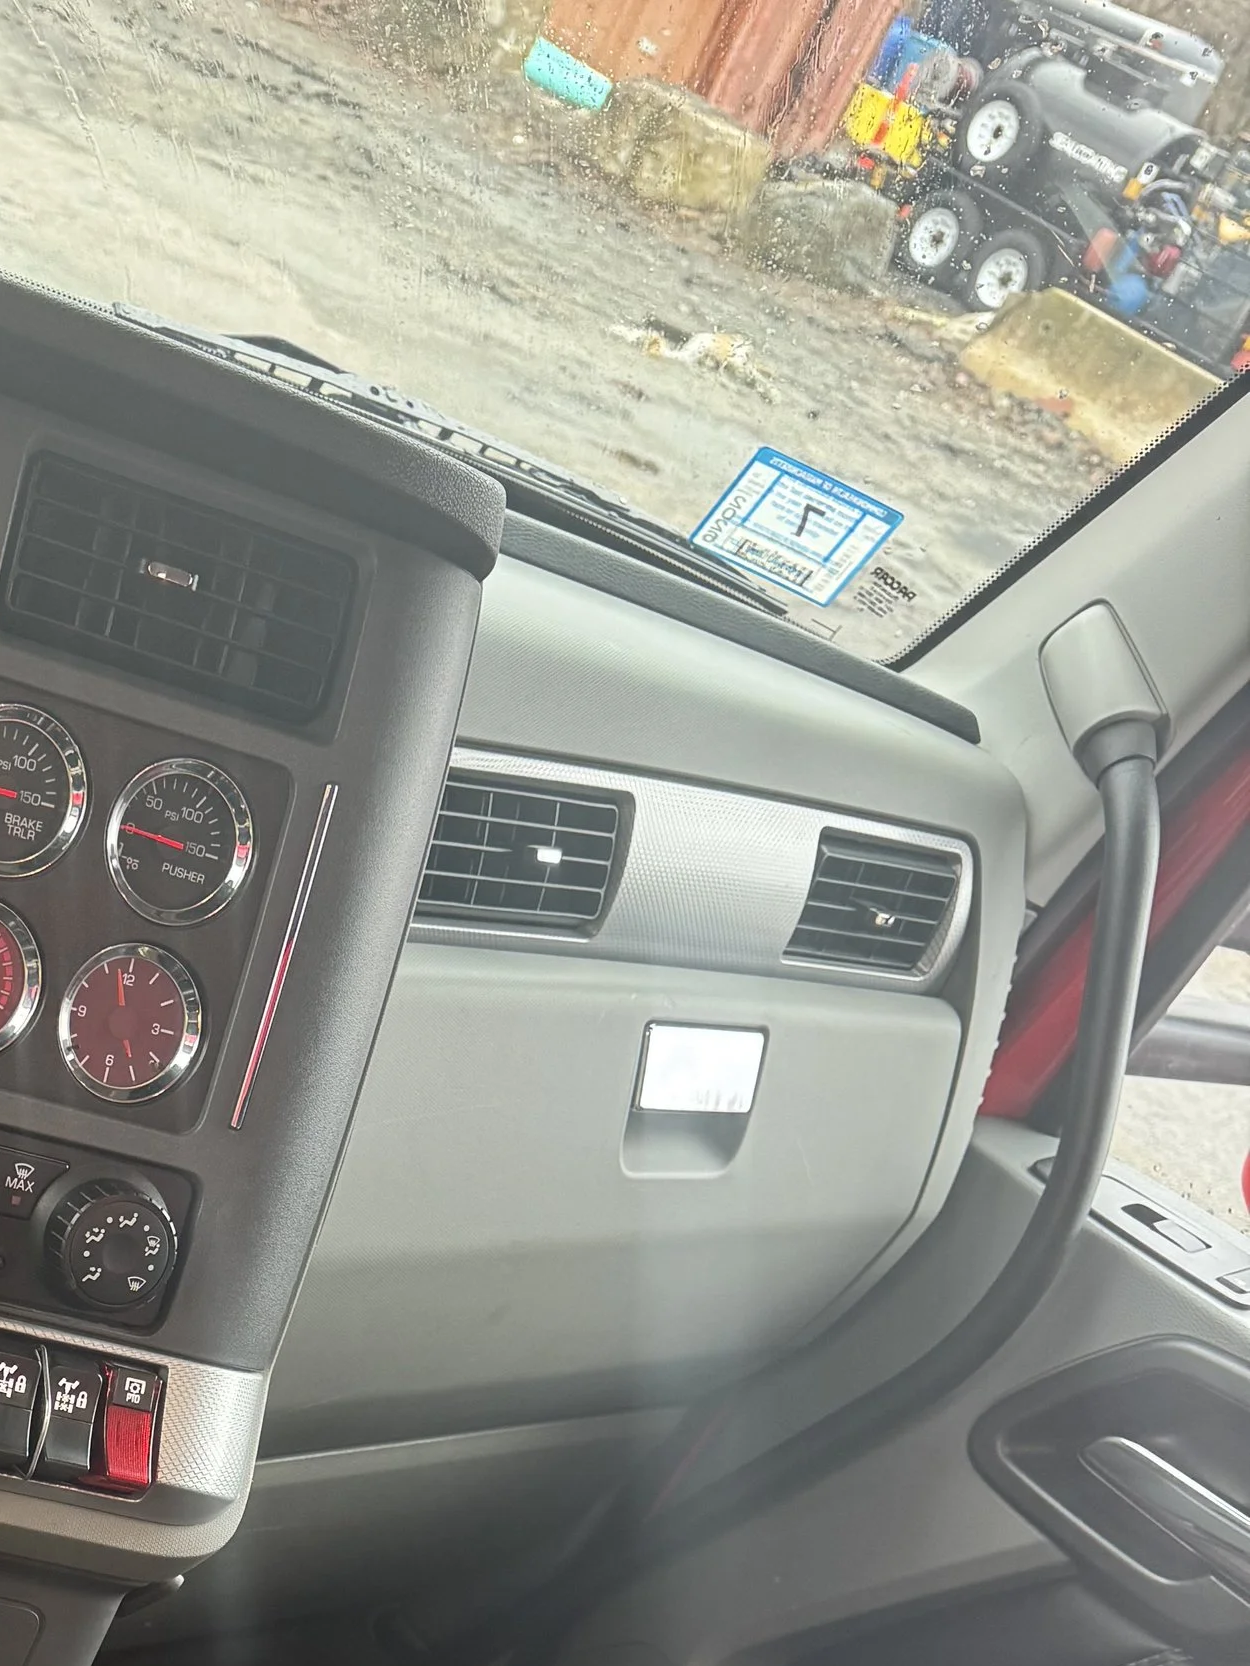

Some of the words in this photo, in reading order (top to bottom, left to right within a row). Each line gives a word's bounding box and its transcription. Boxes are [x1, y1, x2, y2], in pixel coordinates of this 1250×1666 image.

[13, 755, 37, 772] 100
[19, 790, 41, 806] 150
[145, 796, 163, 811] 50
[4, 812, 43, 832] BRAKE
[164, 810, 179, 822] PSI
[181, 806, 204, 824] 100
[7, 824, 36, 841] TRLR
[185, 841, 206, 857] 150
[161, 862, 205, 884] PUSHER
[122, 973, 135, 986] 12
[77, 1006, 87, 1017] 9
[151, 1023, 160, 1035] 3
[105, 1054, 114, 1066] 6
[5, 1175, 35, 1193] MAX
[125, 1392, 141, 1404] PTO
